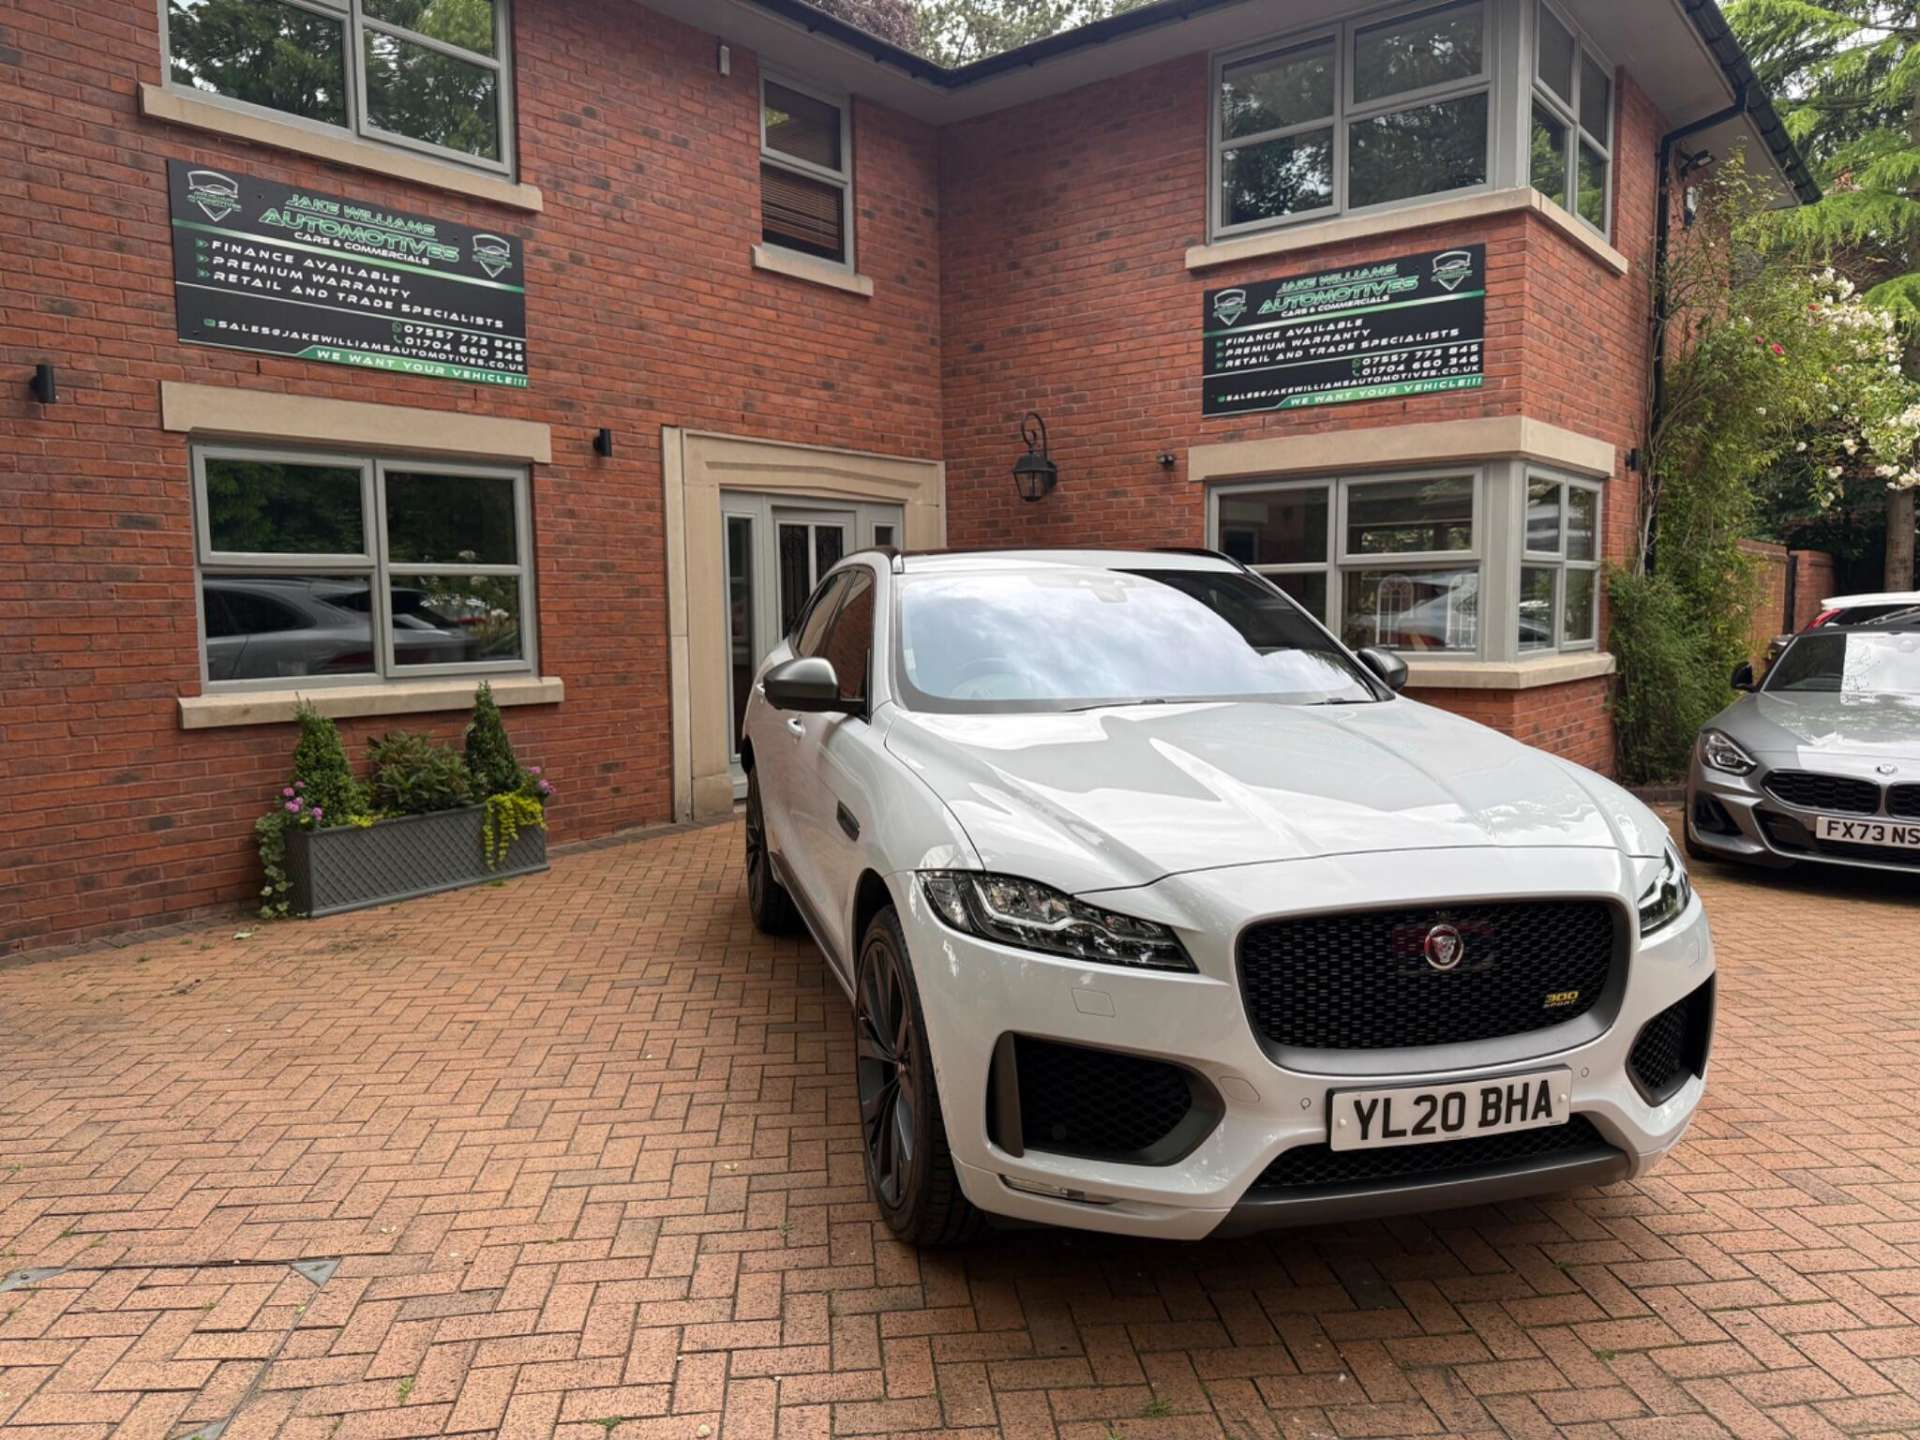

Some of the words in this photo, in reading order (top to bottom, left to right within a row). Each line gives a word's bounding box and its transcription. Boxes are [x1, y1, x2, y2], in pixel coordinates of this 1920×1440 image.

[286, 193, 340, 216] JAKE
[343, 205, 436, 236] WILLIAMS
[258, 207, 459, 263] AUTOMOTIVES
[294, 231, 330, 245] CARS
[333, 239, 341, 247] &
[343, 242, 430, 265] COMMERCIALS
[212, 240, 295, 263] FINANCE
[303, 258, 401, 283] AVAILABLE
[213, 256, 303, 280] PREMIUM
[312, 274, 411, 298] WARRANTY
[213, 271, 282, 290] RETAIL
[291, 285, 328, 298] AND
[337, 292, 393, 309] TRADE
[401, 303, 504, 328] SPECIALISTS
[1257, 275, 1419, 315] AUTOMOTIVES
[1281, 308, 1308, 318] CARS
[1318, 294, 1390, 312] COMMERCIALS
[218, 320, 524, 371] SALES@JAKEWILLIAMSAUTOMOTIVES.CO.UK
[404, 324, 454, 339] 07557
[404, 337, 452, 350] 01704
[459, 345, 488, 357] 660
[495, 350, 523, 361] 346
[1225, 331, 1281, 346] FINANCE
[1286, 318, 1363, 337] AVAILABLE
[1225, 341, 1286, 357] PREMIUM
[1291, 329, 1371, 347] WARRANTY
[1225, 355, 1270, 368] RETAIL
[1275, 350, 1303, 361] AND
[1309, 342, 1355, 356] TRADE
[1360, 328, 1460, 349] SPECIALISTS
[316, 349, 341, 361] WE
[348, 353, 396, 368] WANT
[402, 361, 445, 375] YOUR
[452, 369, 528, 388] VEHICLE!!!
[1361, 364, 1406, 376] 01704
[1412, 360, 1442, 370] 660
[1448, 355, 1479, 365] 346
[1362, 353, 1408, 366] 07557
[1290, 396, 1309, 406] WE
[1315, 391, 1353, 402] WANT
[1359, 386, 1397, 398] YOUR
[1404, 377, 1482, 392] VEHICLE!!!
[1826, 820, 1885, 841] FX73
[1891, 827, 1920, 844] NS
[1353, 1090, 1467, 1140] YL20
[1478, 1080, 1553, 1128] BHA
